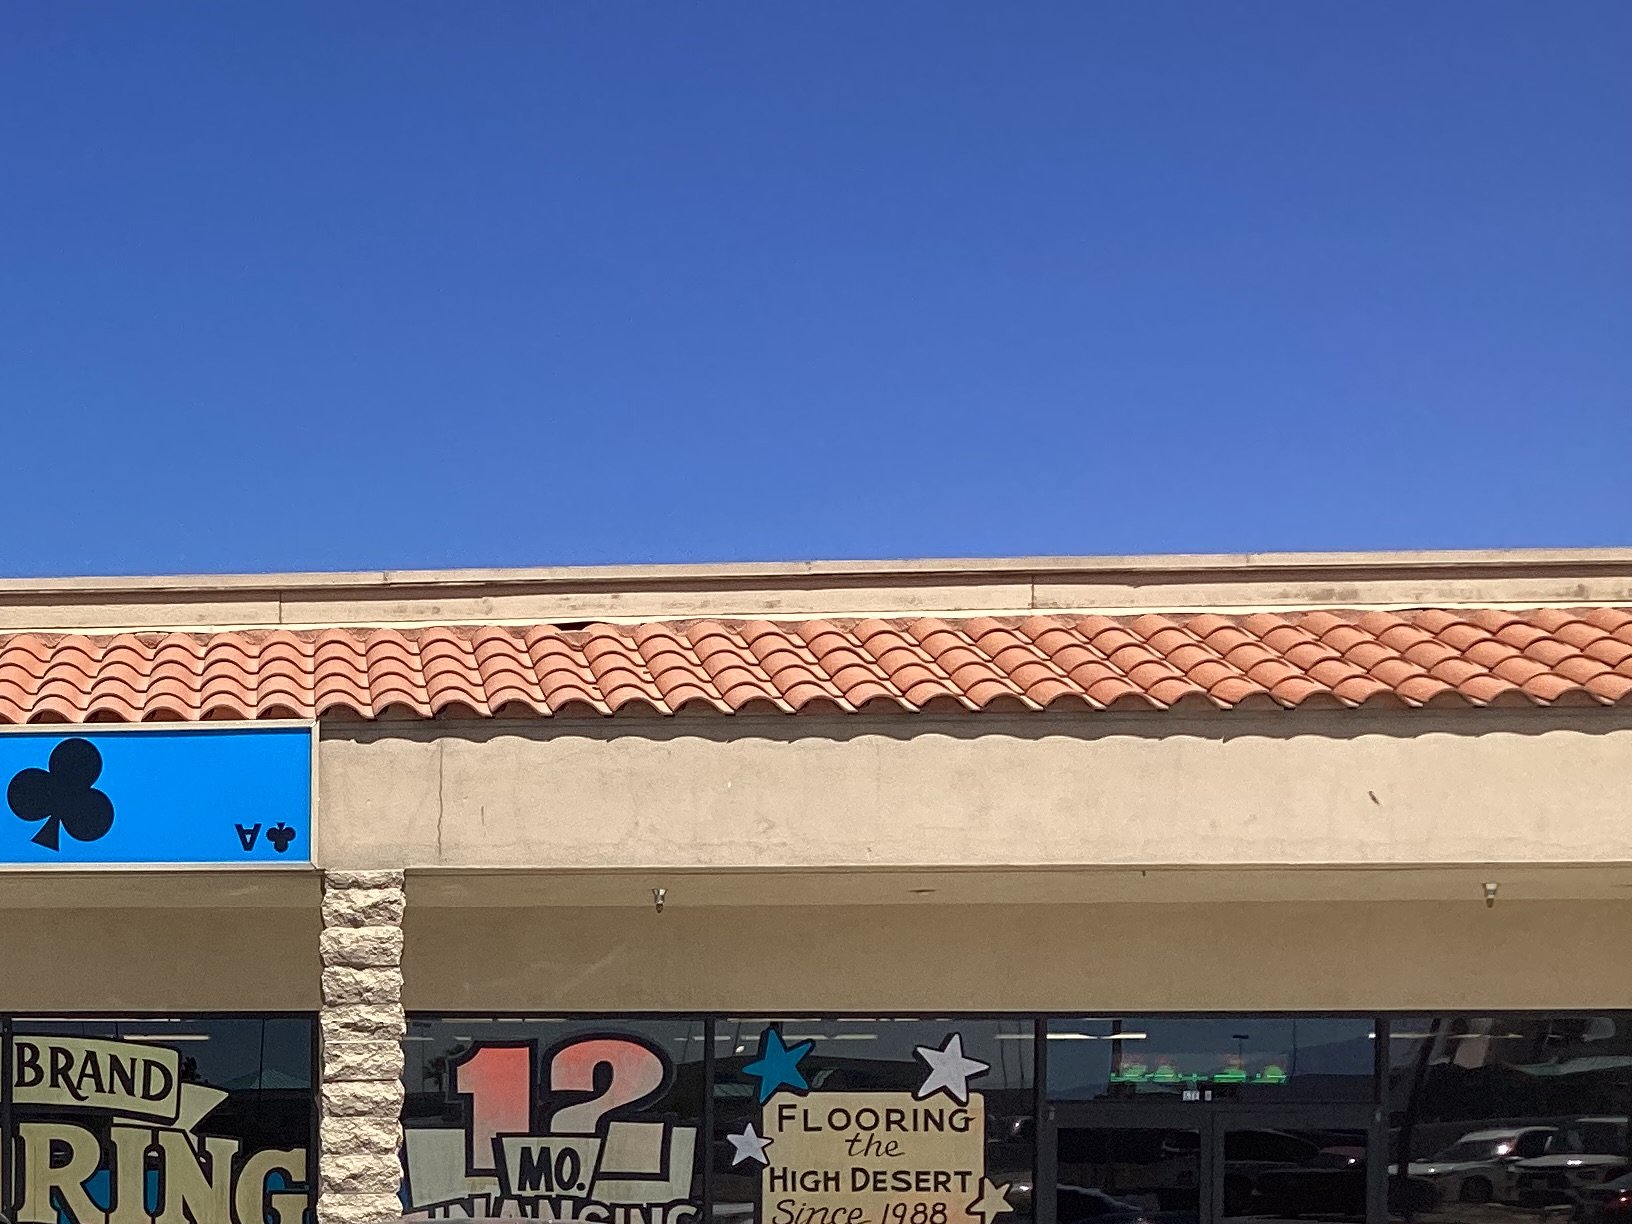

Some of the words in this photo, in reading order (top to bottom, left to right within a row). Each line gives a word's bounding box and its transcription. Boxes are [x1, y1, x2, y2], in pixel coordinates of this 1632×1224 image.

[14, 1041, 176, 1103] BRAND
[456, 1038, 665, 1174] 12
[777, 1103, 976, 1133] FLOORING
[844, 1132, 906, 1158] the
[518, 1145, 587, 1192] MO.
[769, 1166, 841, 1193] HIGH
[851, 1167, 973, 1193] DESERT
